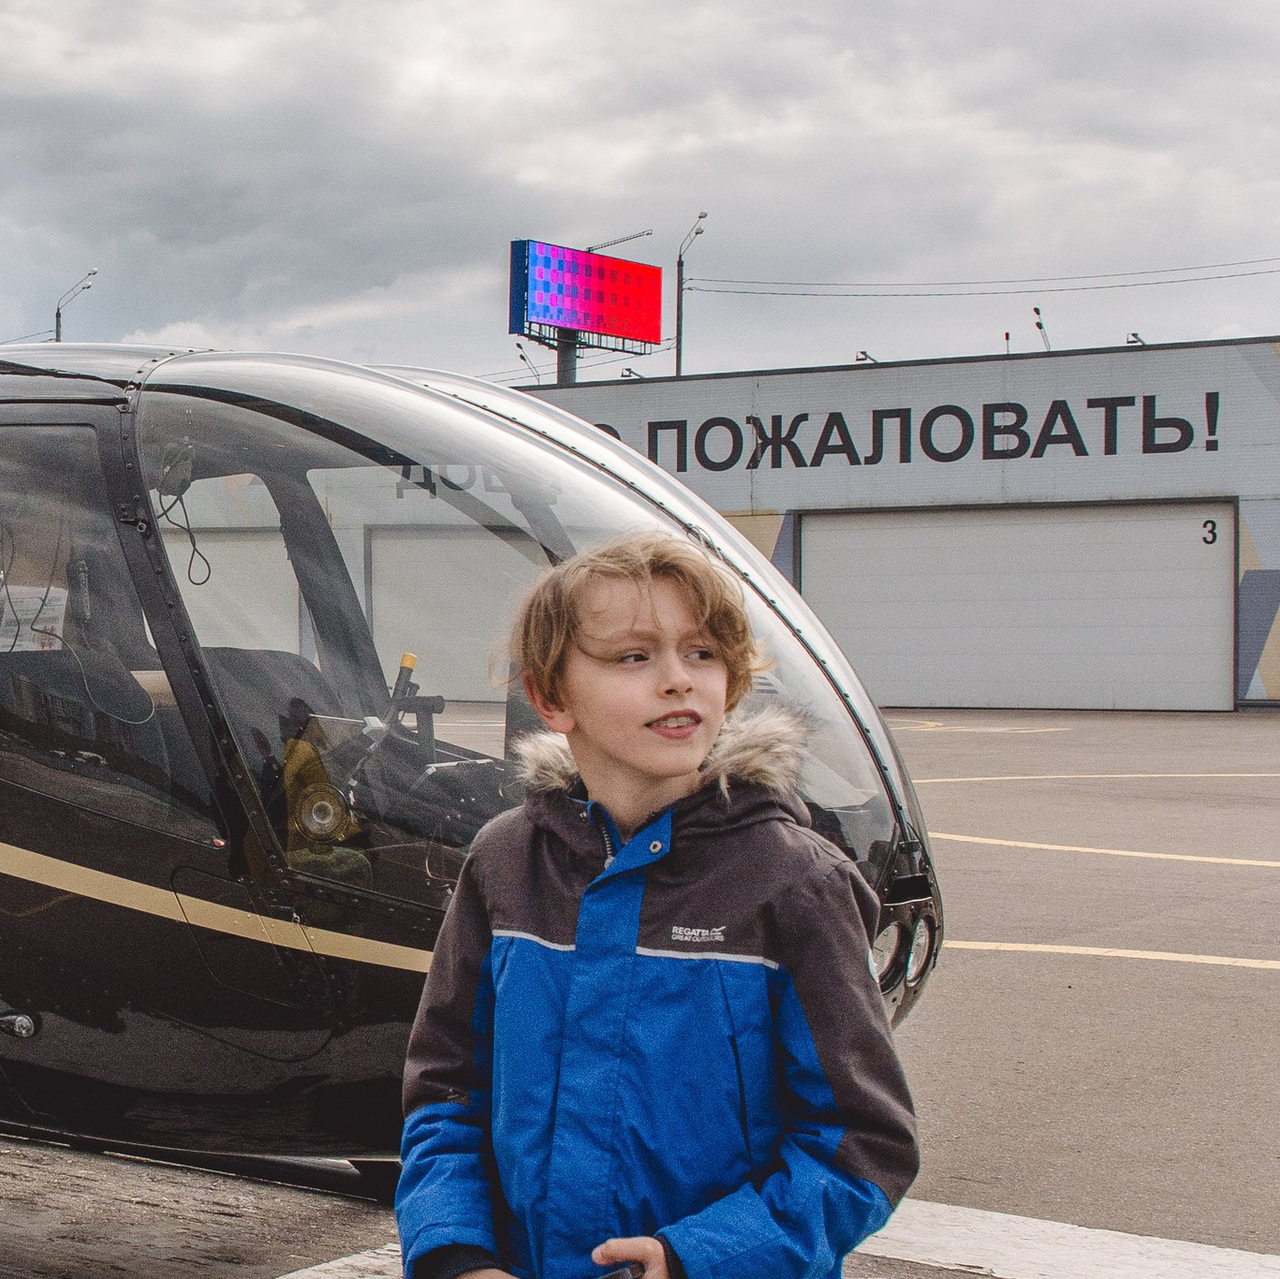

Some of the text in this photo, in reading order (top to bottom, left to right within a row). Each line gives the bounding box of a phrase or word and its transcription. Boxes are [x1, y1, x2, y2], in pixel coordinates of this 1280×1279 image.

[647, 391, 1220, 473] ПОЖАЛОВАТЬ!
[1202, 519, 1218, 545] 3
[672, 926, 709, 937] REGATTA
